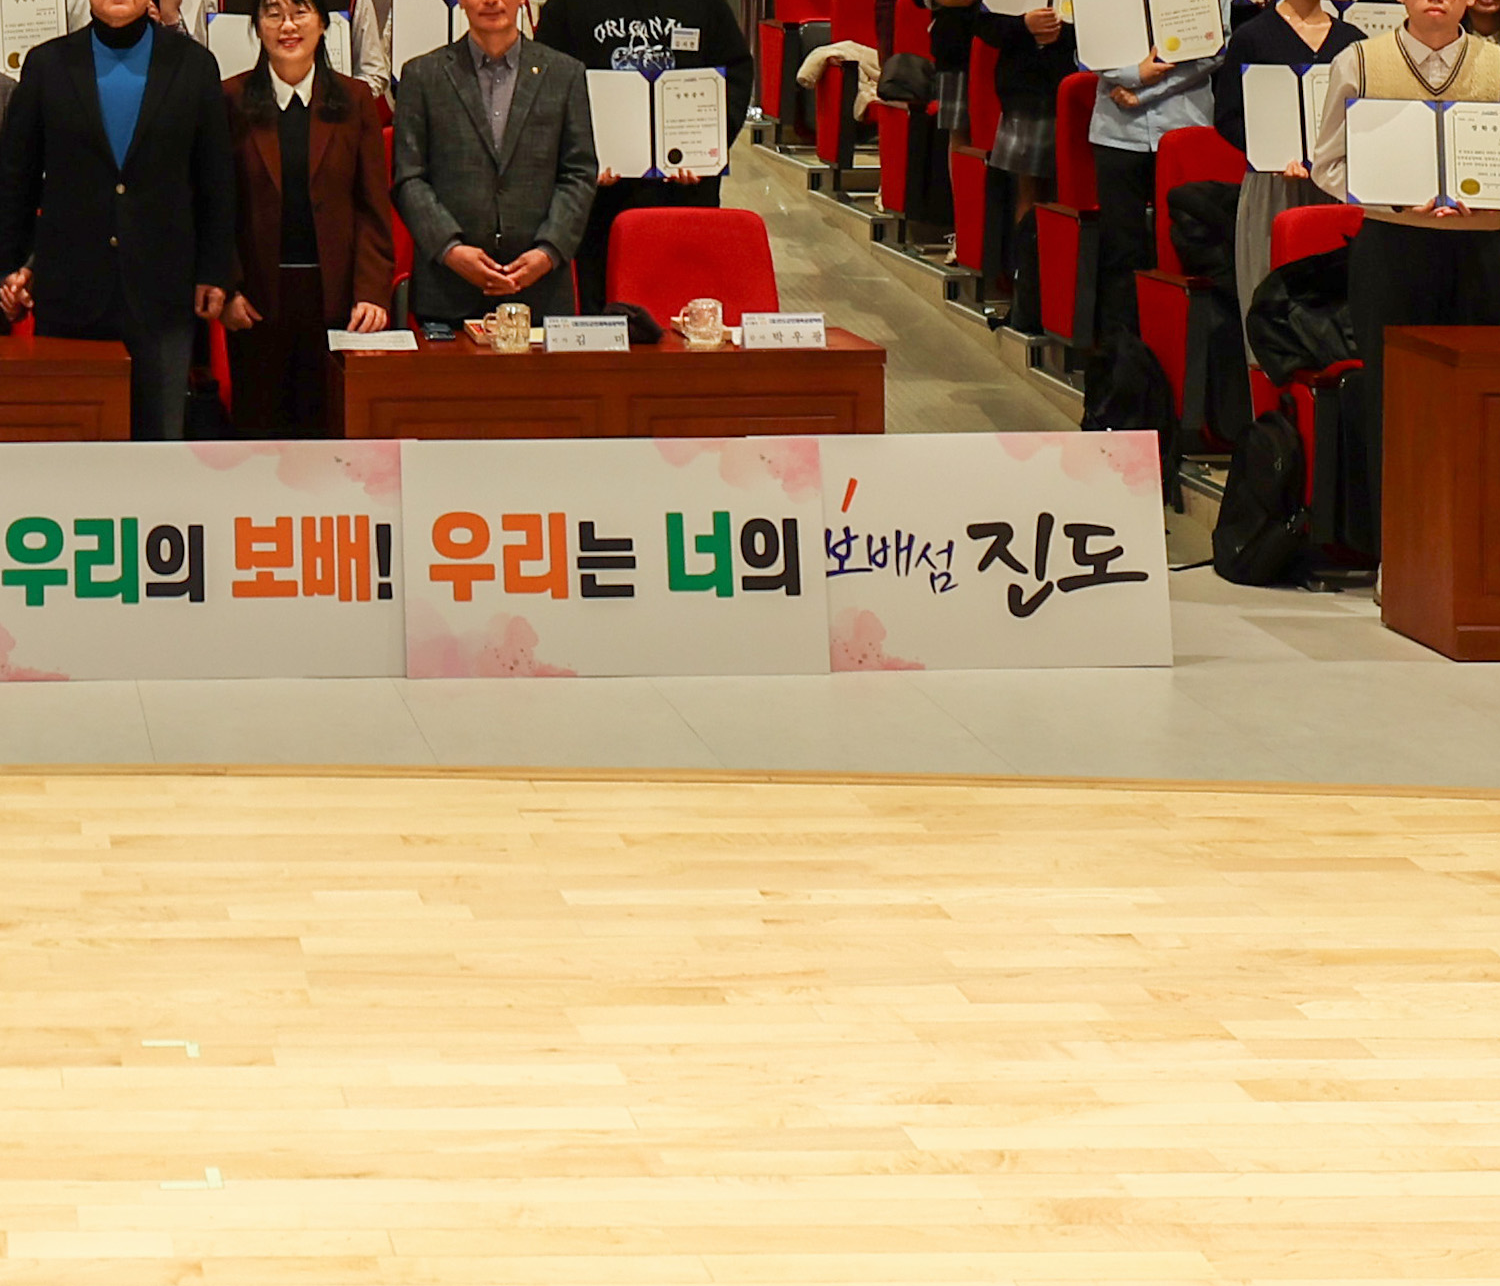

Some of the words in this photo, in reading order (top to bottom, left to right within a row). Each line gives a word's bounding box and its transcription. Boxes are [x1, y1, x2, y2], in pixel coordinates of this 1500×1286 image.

[1, 516, 205, 606] 우리의
[231, 514, 393, 602] 보배!
[429, 511, 636, 602] 우리는
[665, 511, 801, 598] 너의
[966, 512, 1149, 618] 진도
